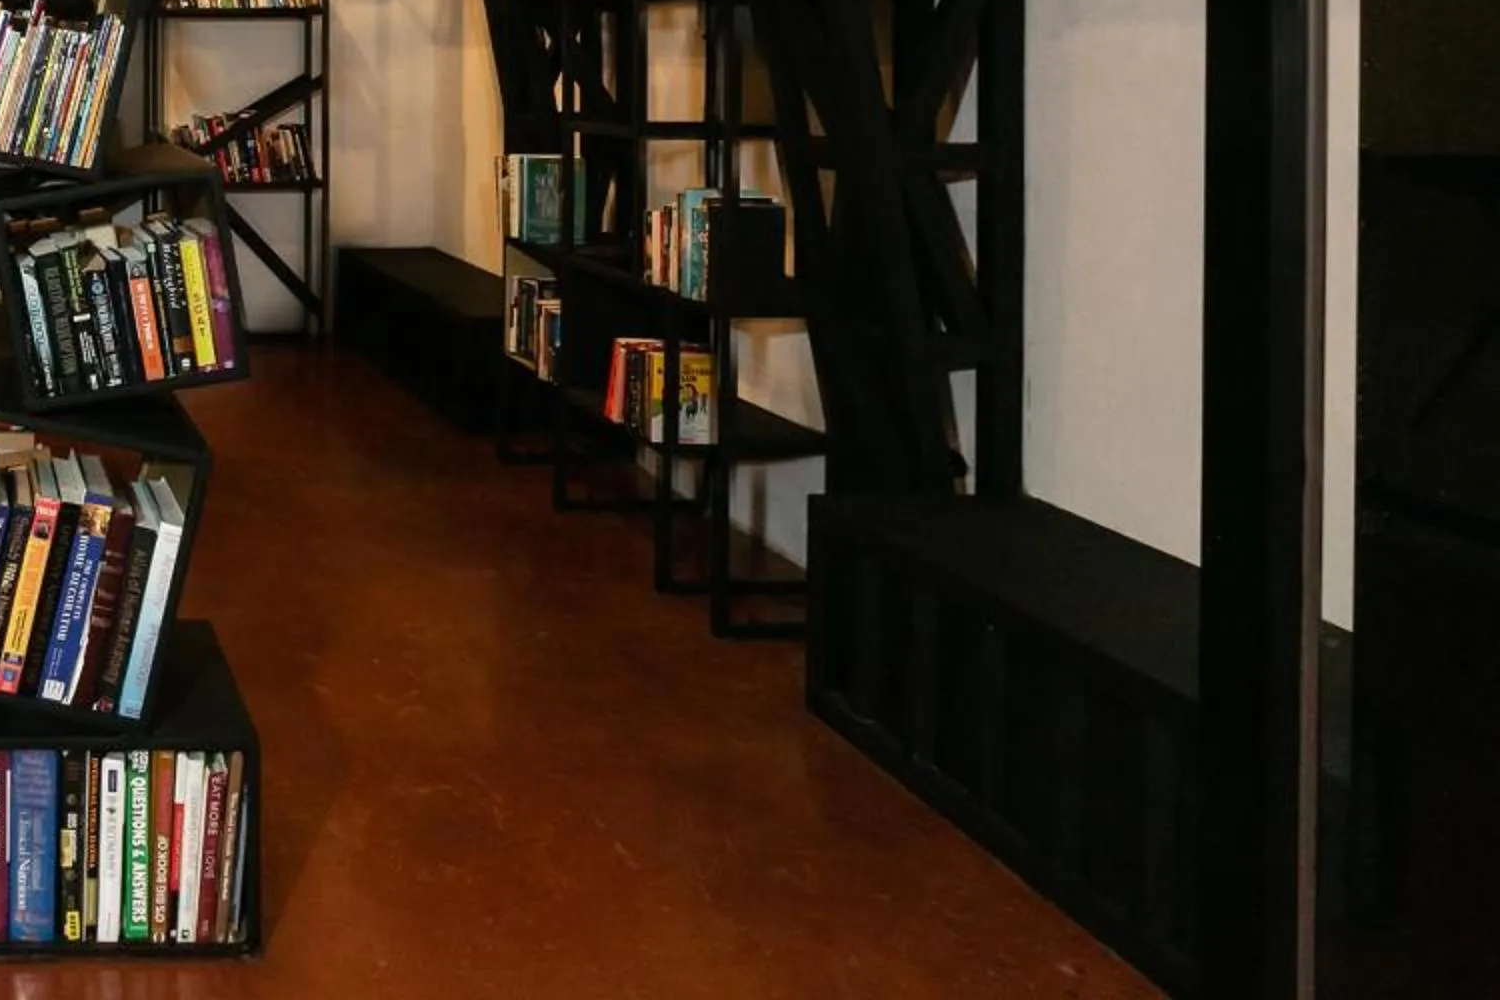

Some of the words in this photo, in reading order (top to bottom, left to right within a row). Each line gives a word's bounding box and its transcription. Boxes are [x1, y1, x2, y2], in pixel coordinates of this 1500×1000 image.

[56, 572, 81, 641] DECORATOR
[131, 777, 148, 847] QUESTIONS
[208, 800, 220, 836] MORE
[17, 856, 30, 911] Nutrition
[132, 862, 148, 923] ANSWERS
[203, 853, 216, 879] LOVE
